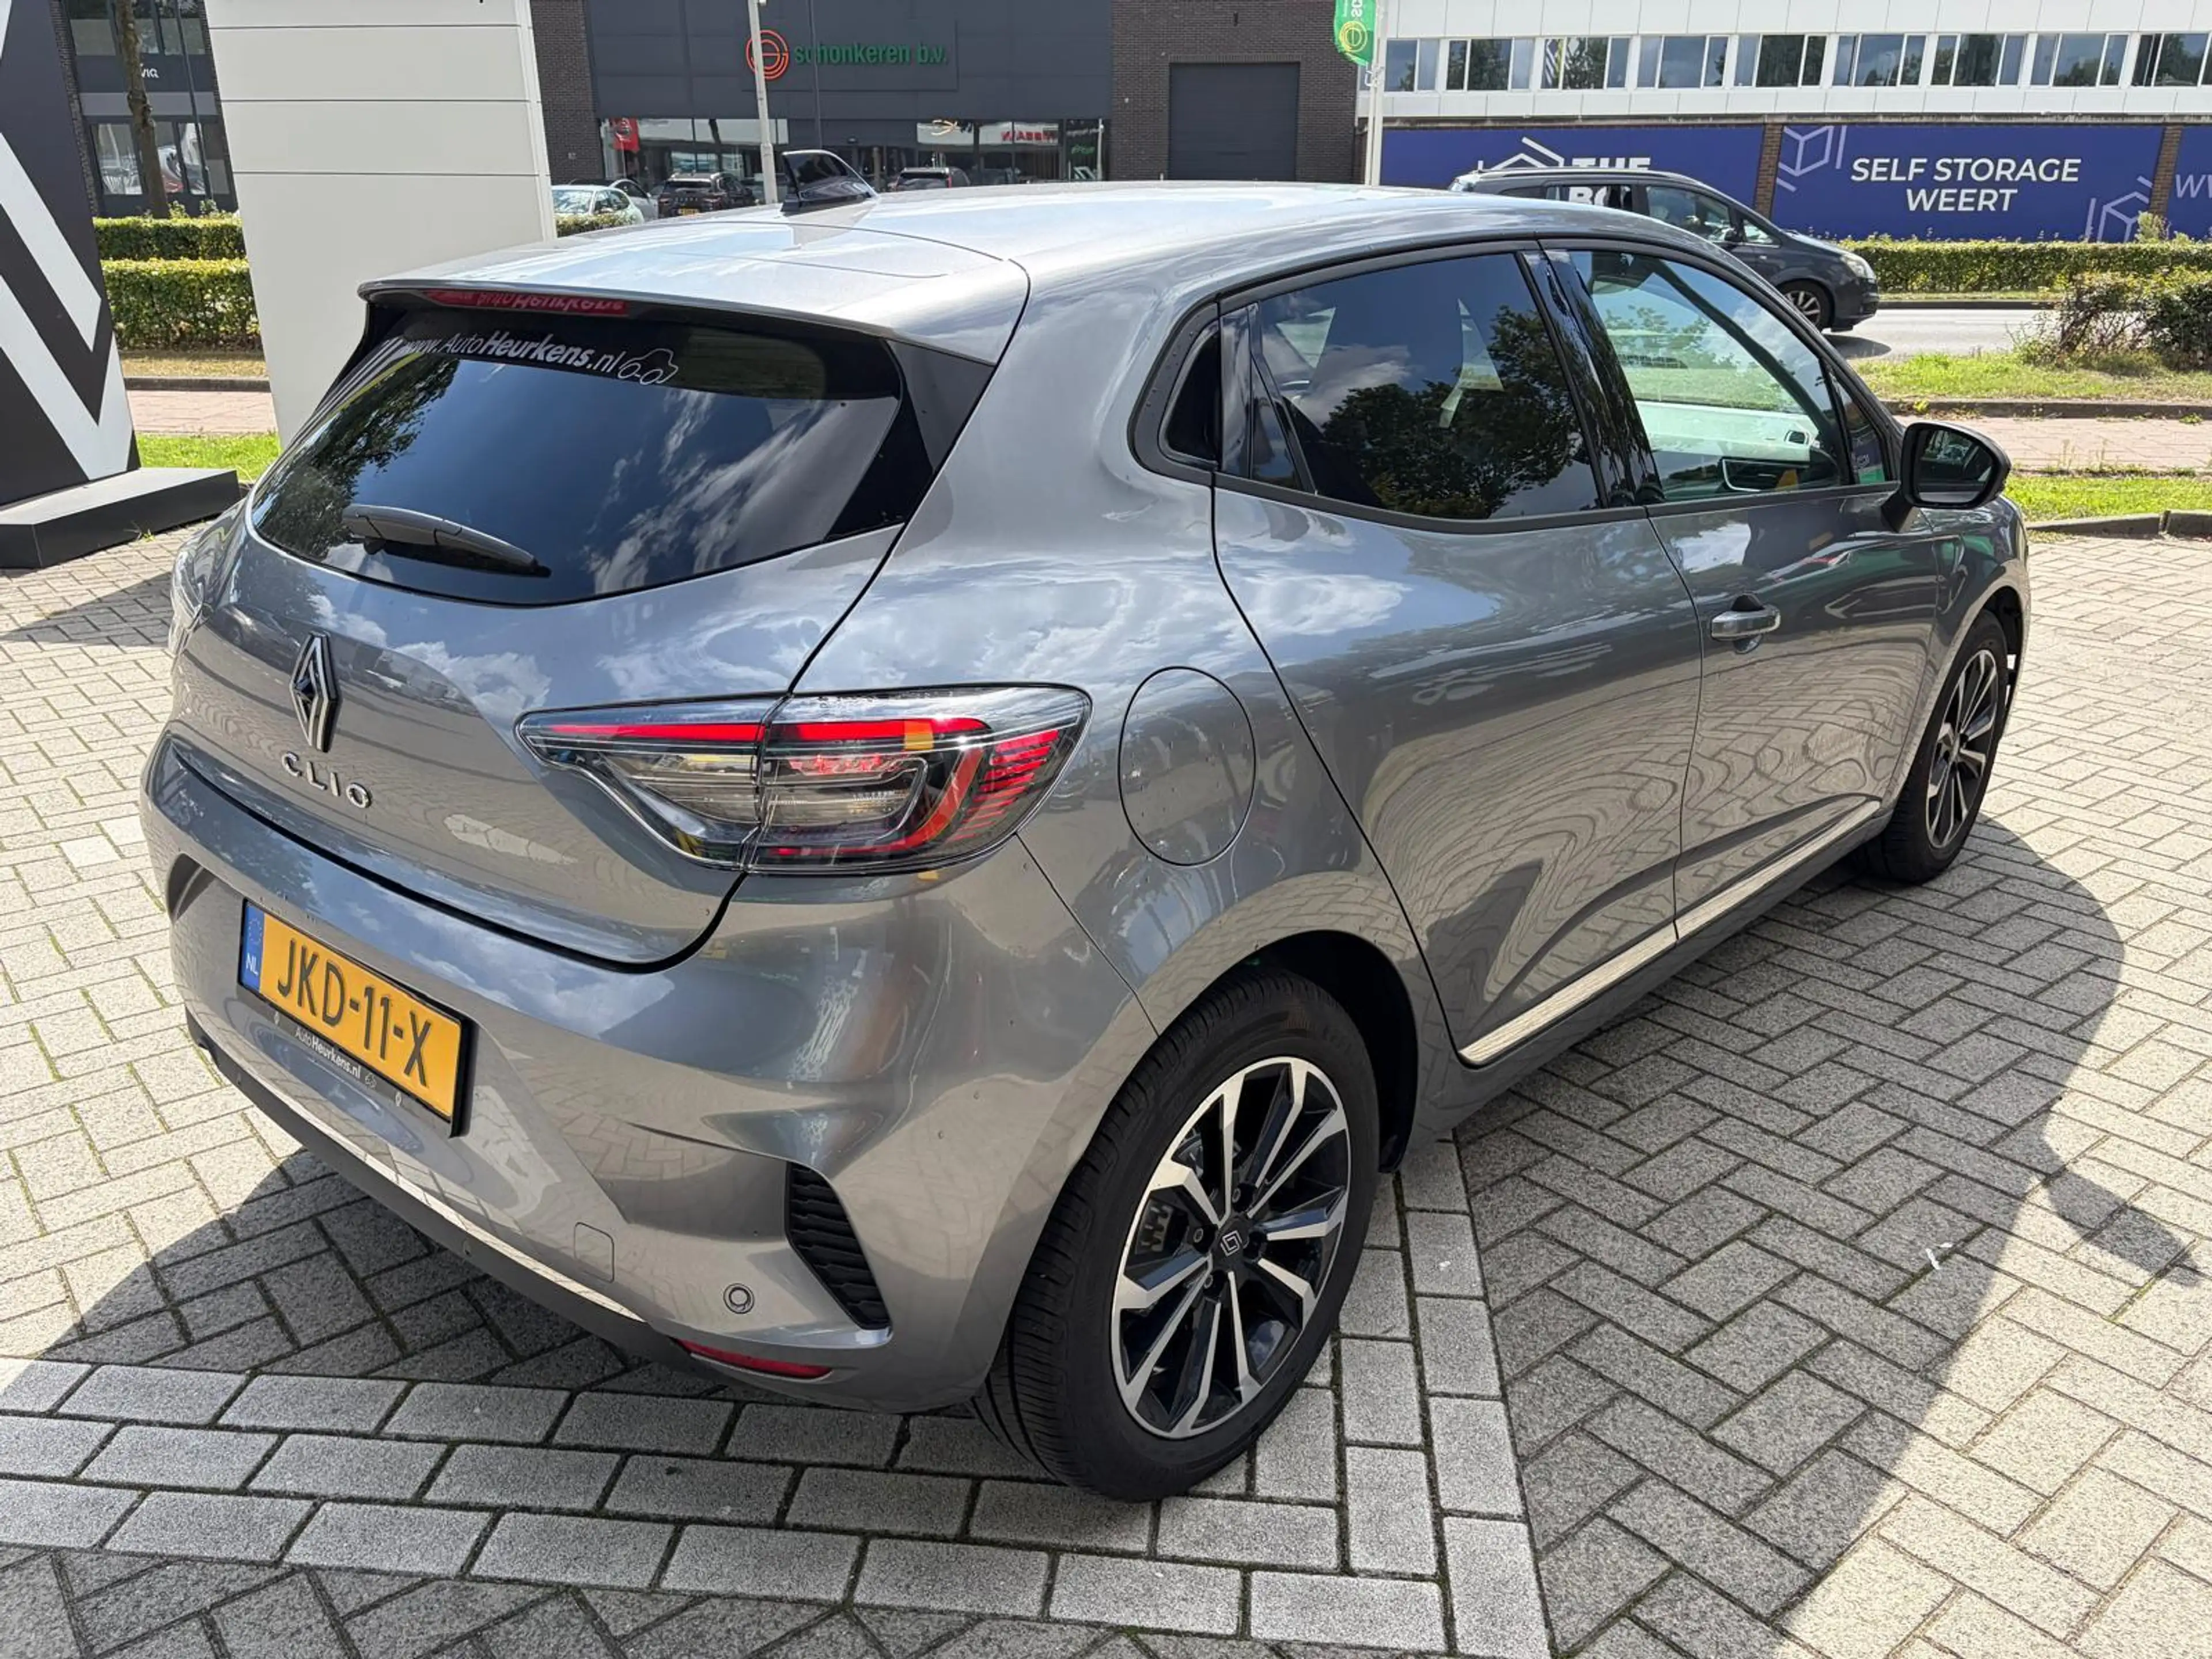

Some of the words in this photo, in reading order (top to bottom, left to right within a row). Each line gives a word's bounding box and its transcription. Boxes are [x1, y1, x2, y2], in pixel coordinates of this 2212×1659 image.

[794, 41, 911, 66] schonkeren
[917, 40, 949, 66] b.v.
[1850, 157, 1928, 182] SELF
[1933, 157, 2081, 183] STORAGE
[1906, 188, 2018, 212] WEERT
[281, 751, 372, 809] CLIO
[245, 953, 259, 976] NL
[276, 938, 432, 1089] JKD-11-X
[294, 1025, 361, 1079] AutoHeurkens.nl
